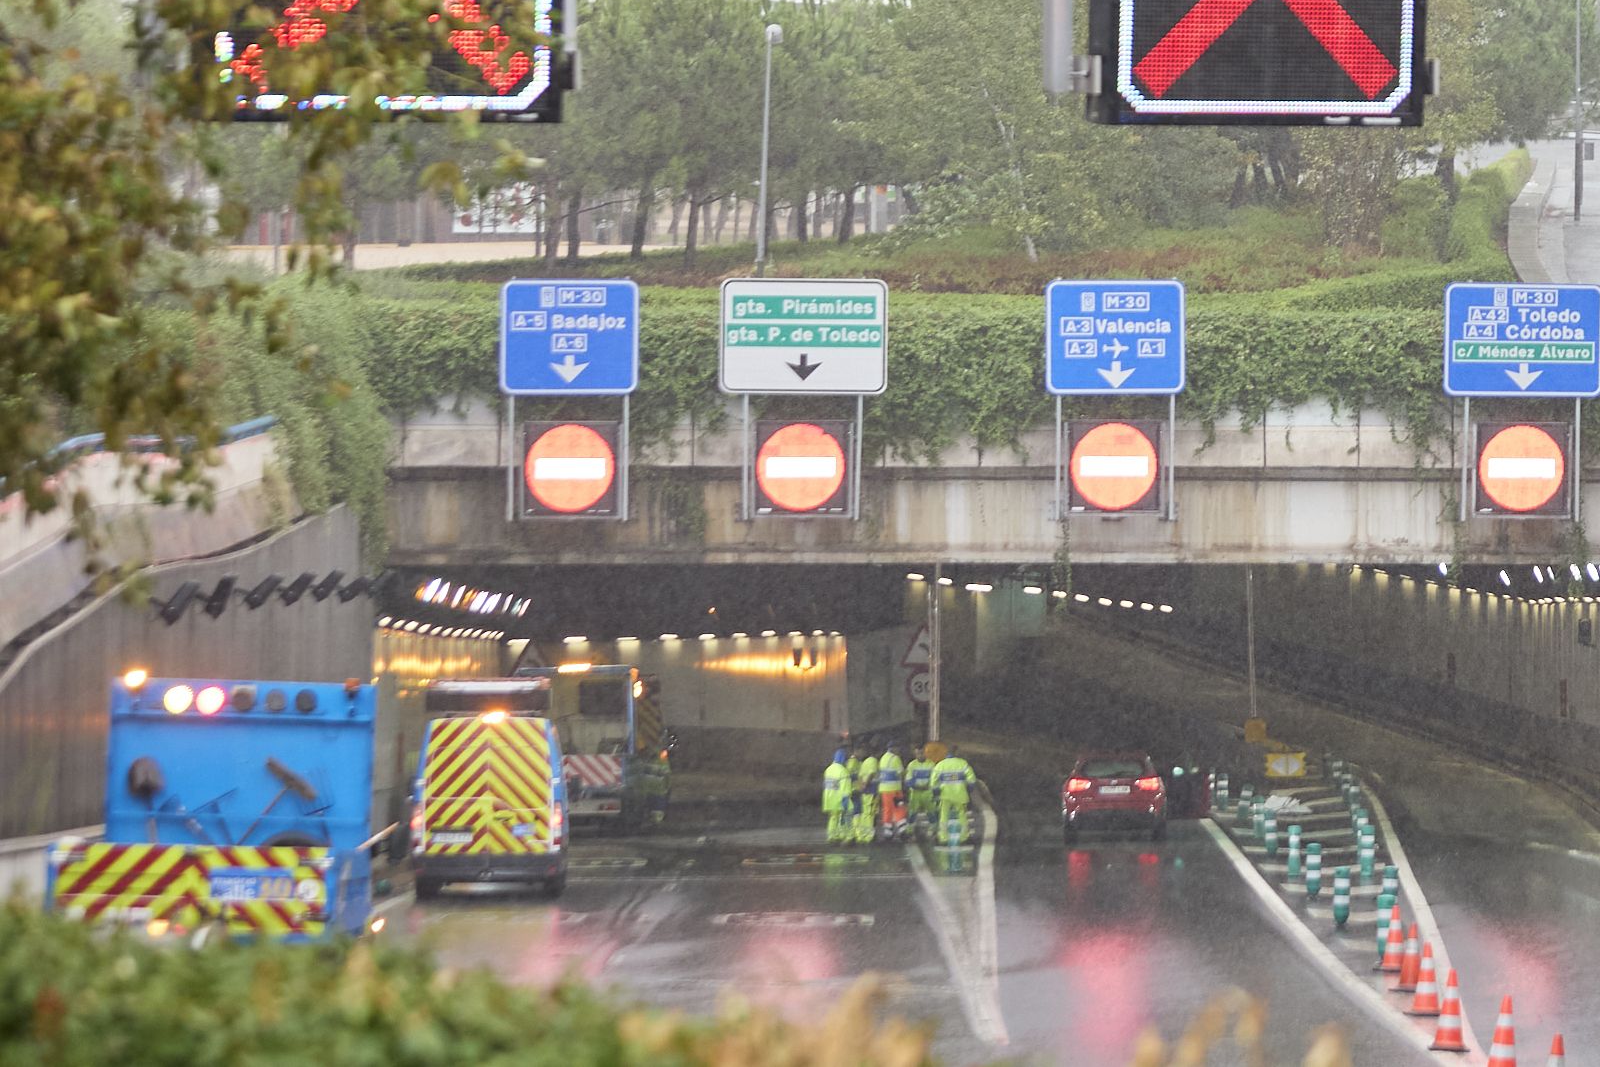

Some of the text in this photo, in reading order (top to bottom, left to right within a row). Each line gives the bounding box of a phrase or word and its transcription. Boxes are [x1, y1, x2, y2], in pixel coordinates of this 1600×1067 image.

[562, 290, 602, 303] M-30
[1106, 295, 1146, 308] M-30
[1515, 292, 1555, 304] M-30
[734, 298, 874, 317] gta. Pirámides
[515, 313, 626, 332] A-5 Badajoz
[1471, 308, 1581, 323] A-42 Toledo
[1065, 318, 1172, 334] A-3 Valencia
[1467, 324, 1585, 340] A-4 Córdoba
[727, 325, 881, 344] gta. P. de Toledo
[556, 336, 584, 349] A-6
[1069, 342, 1163, 354] A-2 A-1
[1457, 344, 1591, 359] c/ Méndez Álvaro
